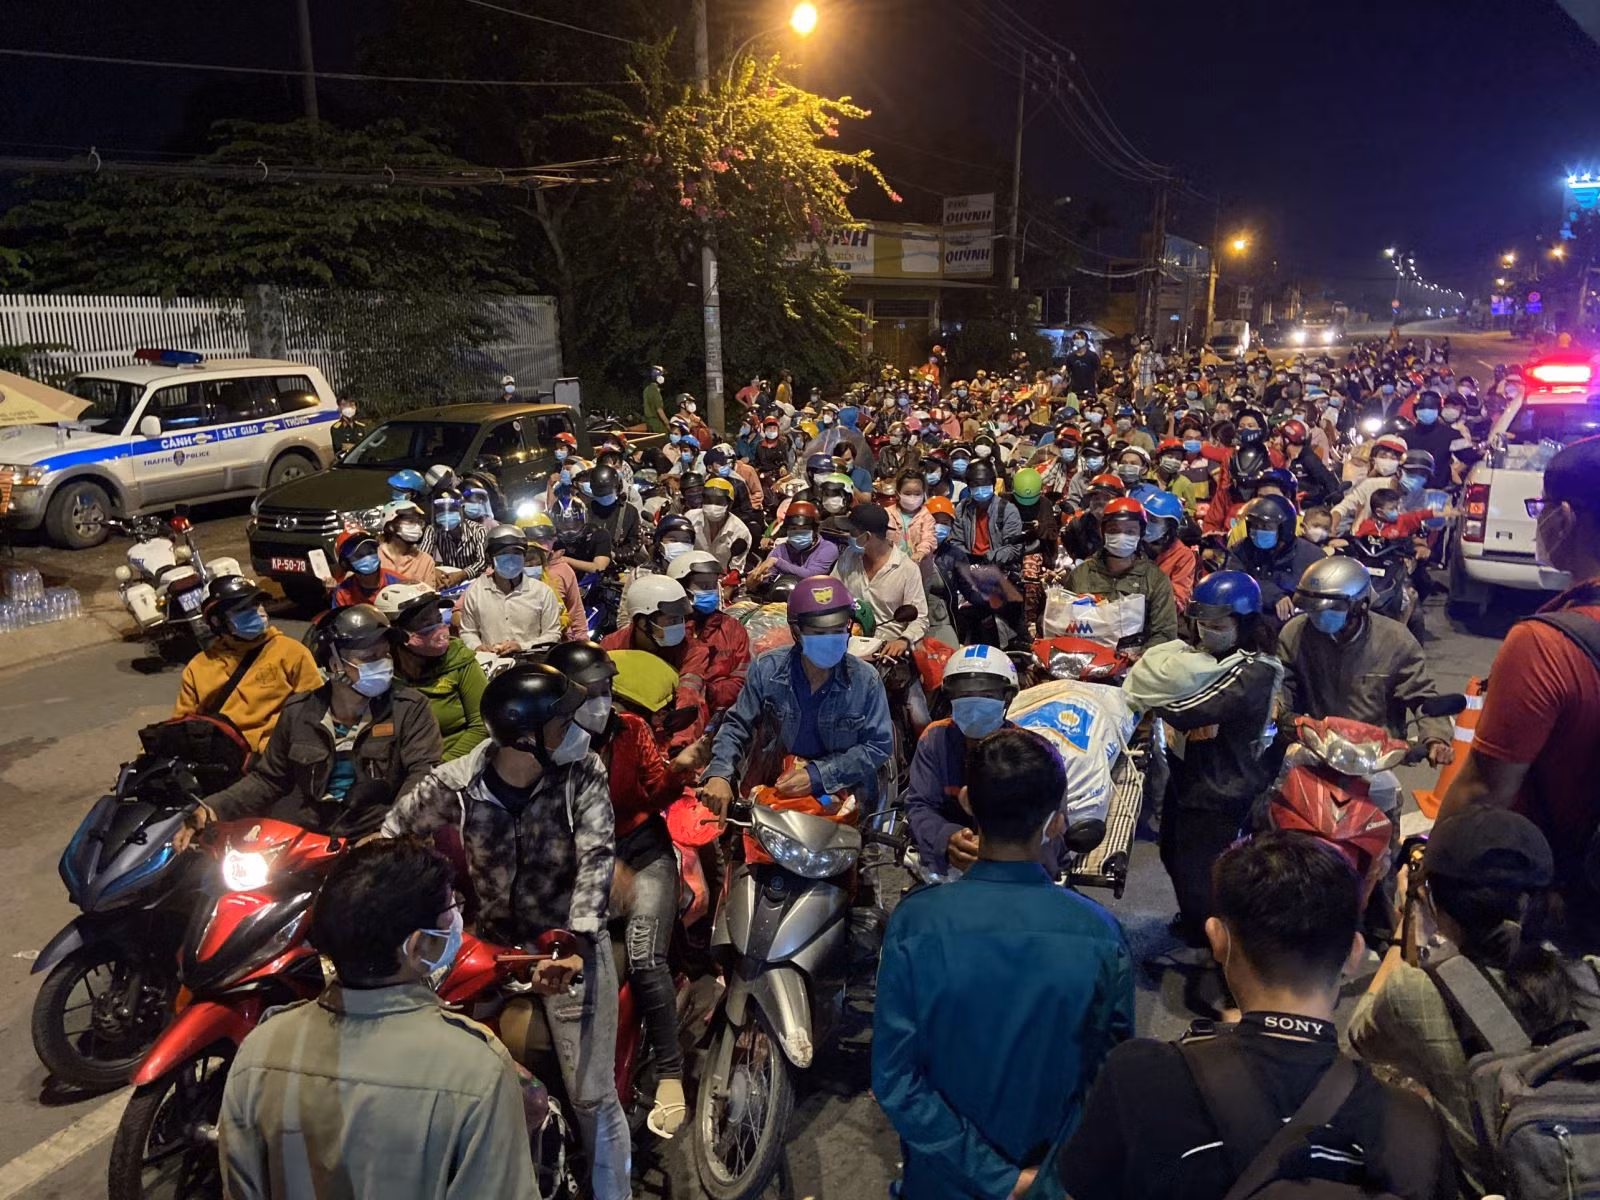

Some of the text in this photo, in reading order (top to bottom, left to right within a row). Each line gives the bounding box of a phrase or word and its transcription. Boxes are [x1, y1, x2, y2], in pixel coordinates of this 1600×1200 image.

[222, 427, 237, 439] SÁT
[240, 425, 259, 435] GIAO
[144, 450, 210, 466] TRAFFIC POLICE
[271, 557, 306, 571] KP-50-78
[1264, 1016, 1324, 1035] SONY
